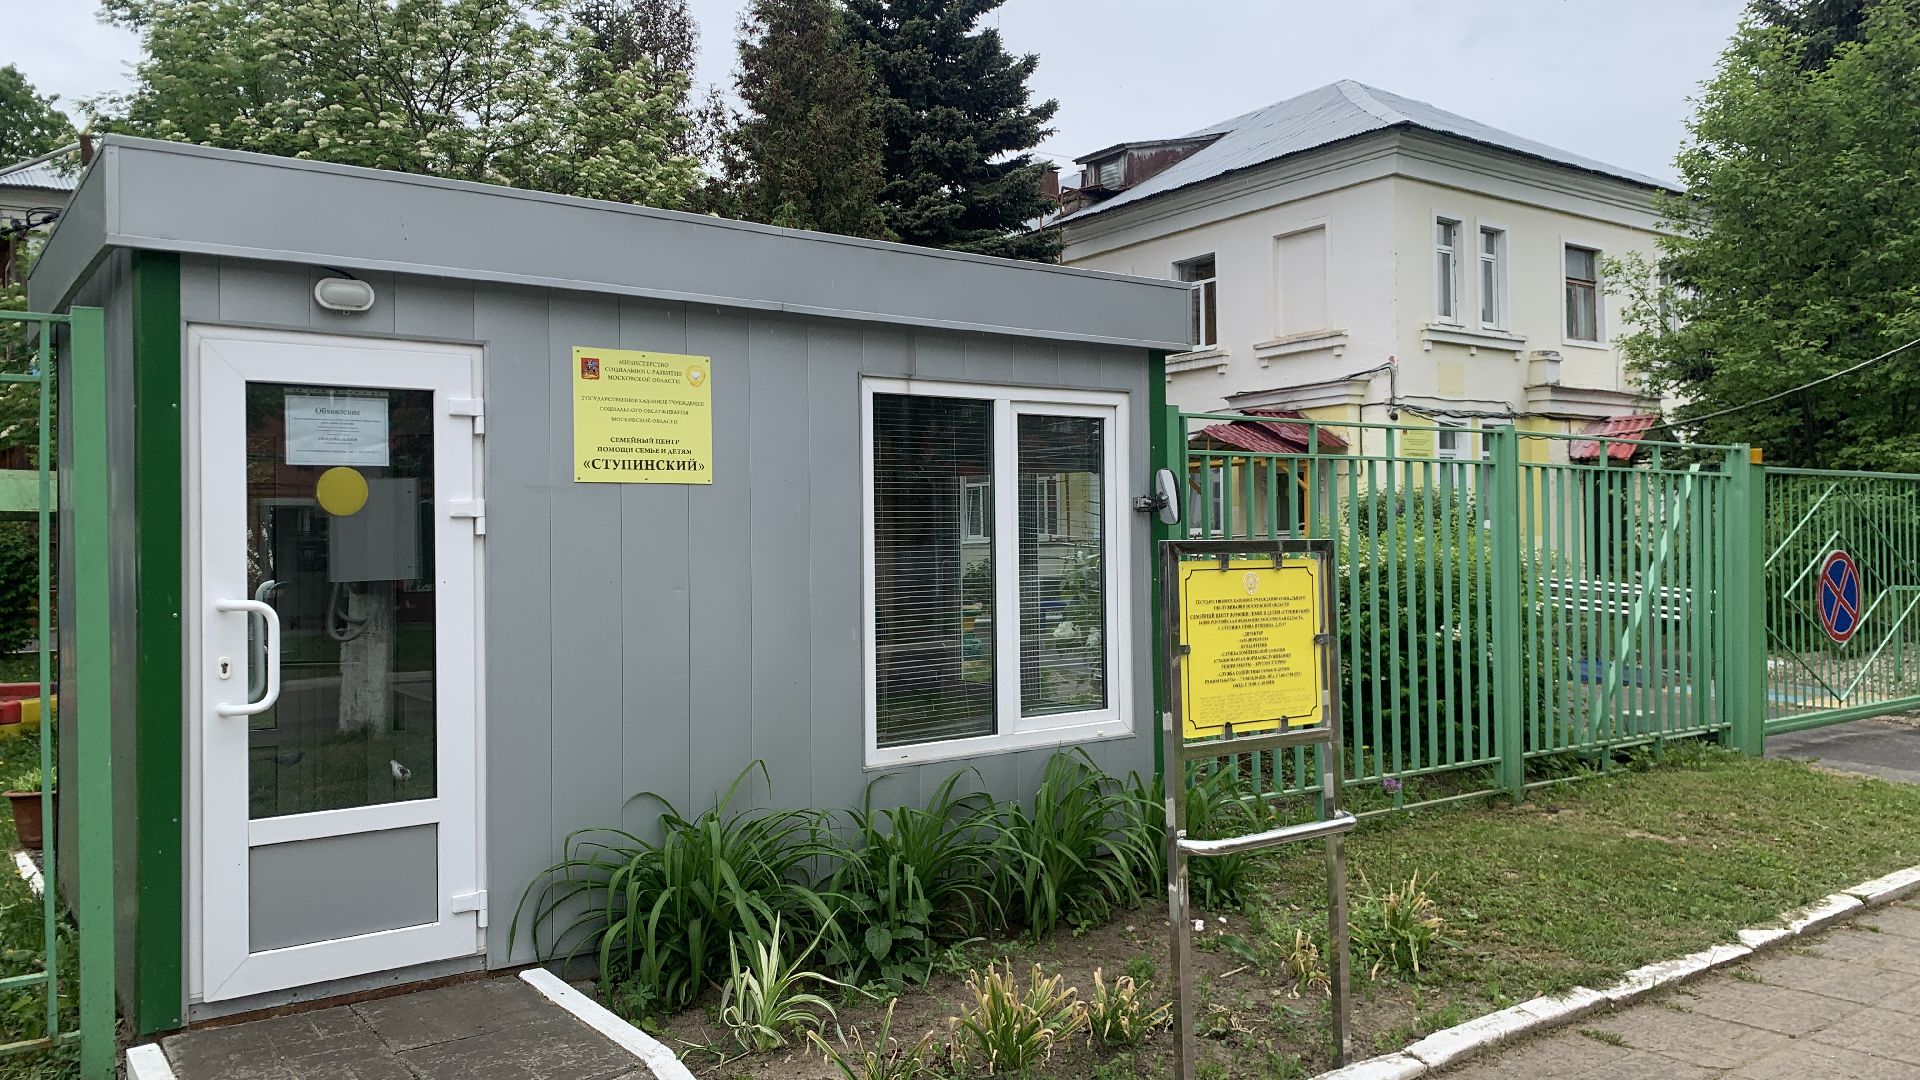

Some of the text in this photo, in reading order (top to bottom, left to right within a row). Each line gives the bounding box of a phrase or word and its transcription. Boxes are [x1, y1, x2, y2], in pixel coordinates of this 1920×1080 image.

[608, 374, 650, 382] МОСКОВСКОЙ
[611, 416, 651, 424] МОСКОВСКОЙ
[610, 436, 654, 444] СЕМЕЙНЫЙ
[597, 446, 633, 454] ПОМОЩИ
[583, 458, 705, 471] «СТУПИНСКИЙ»
